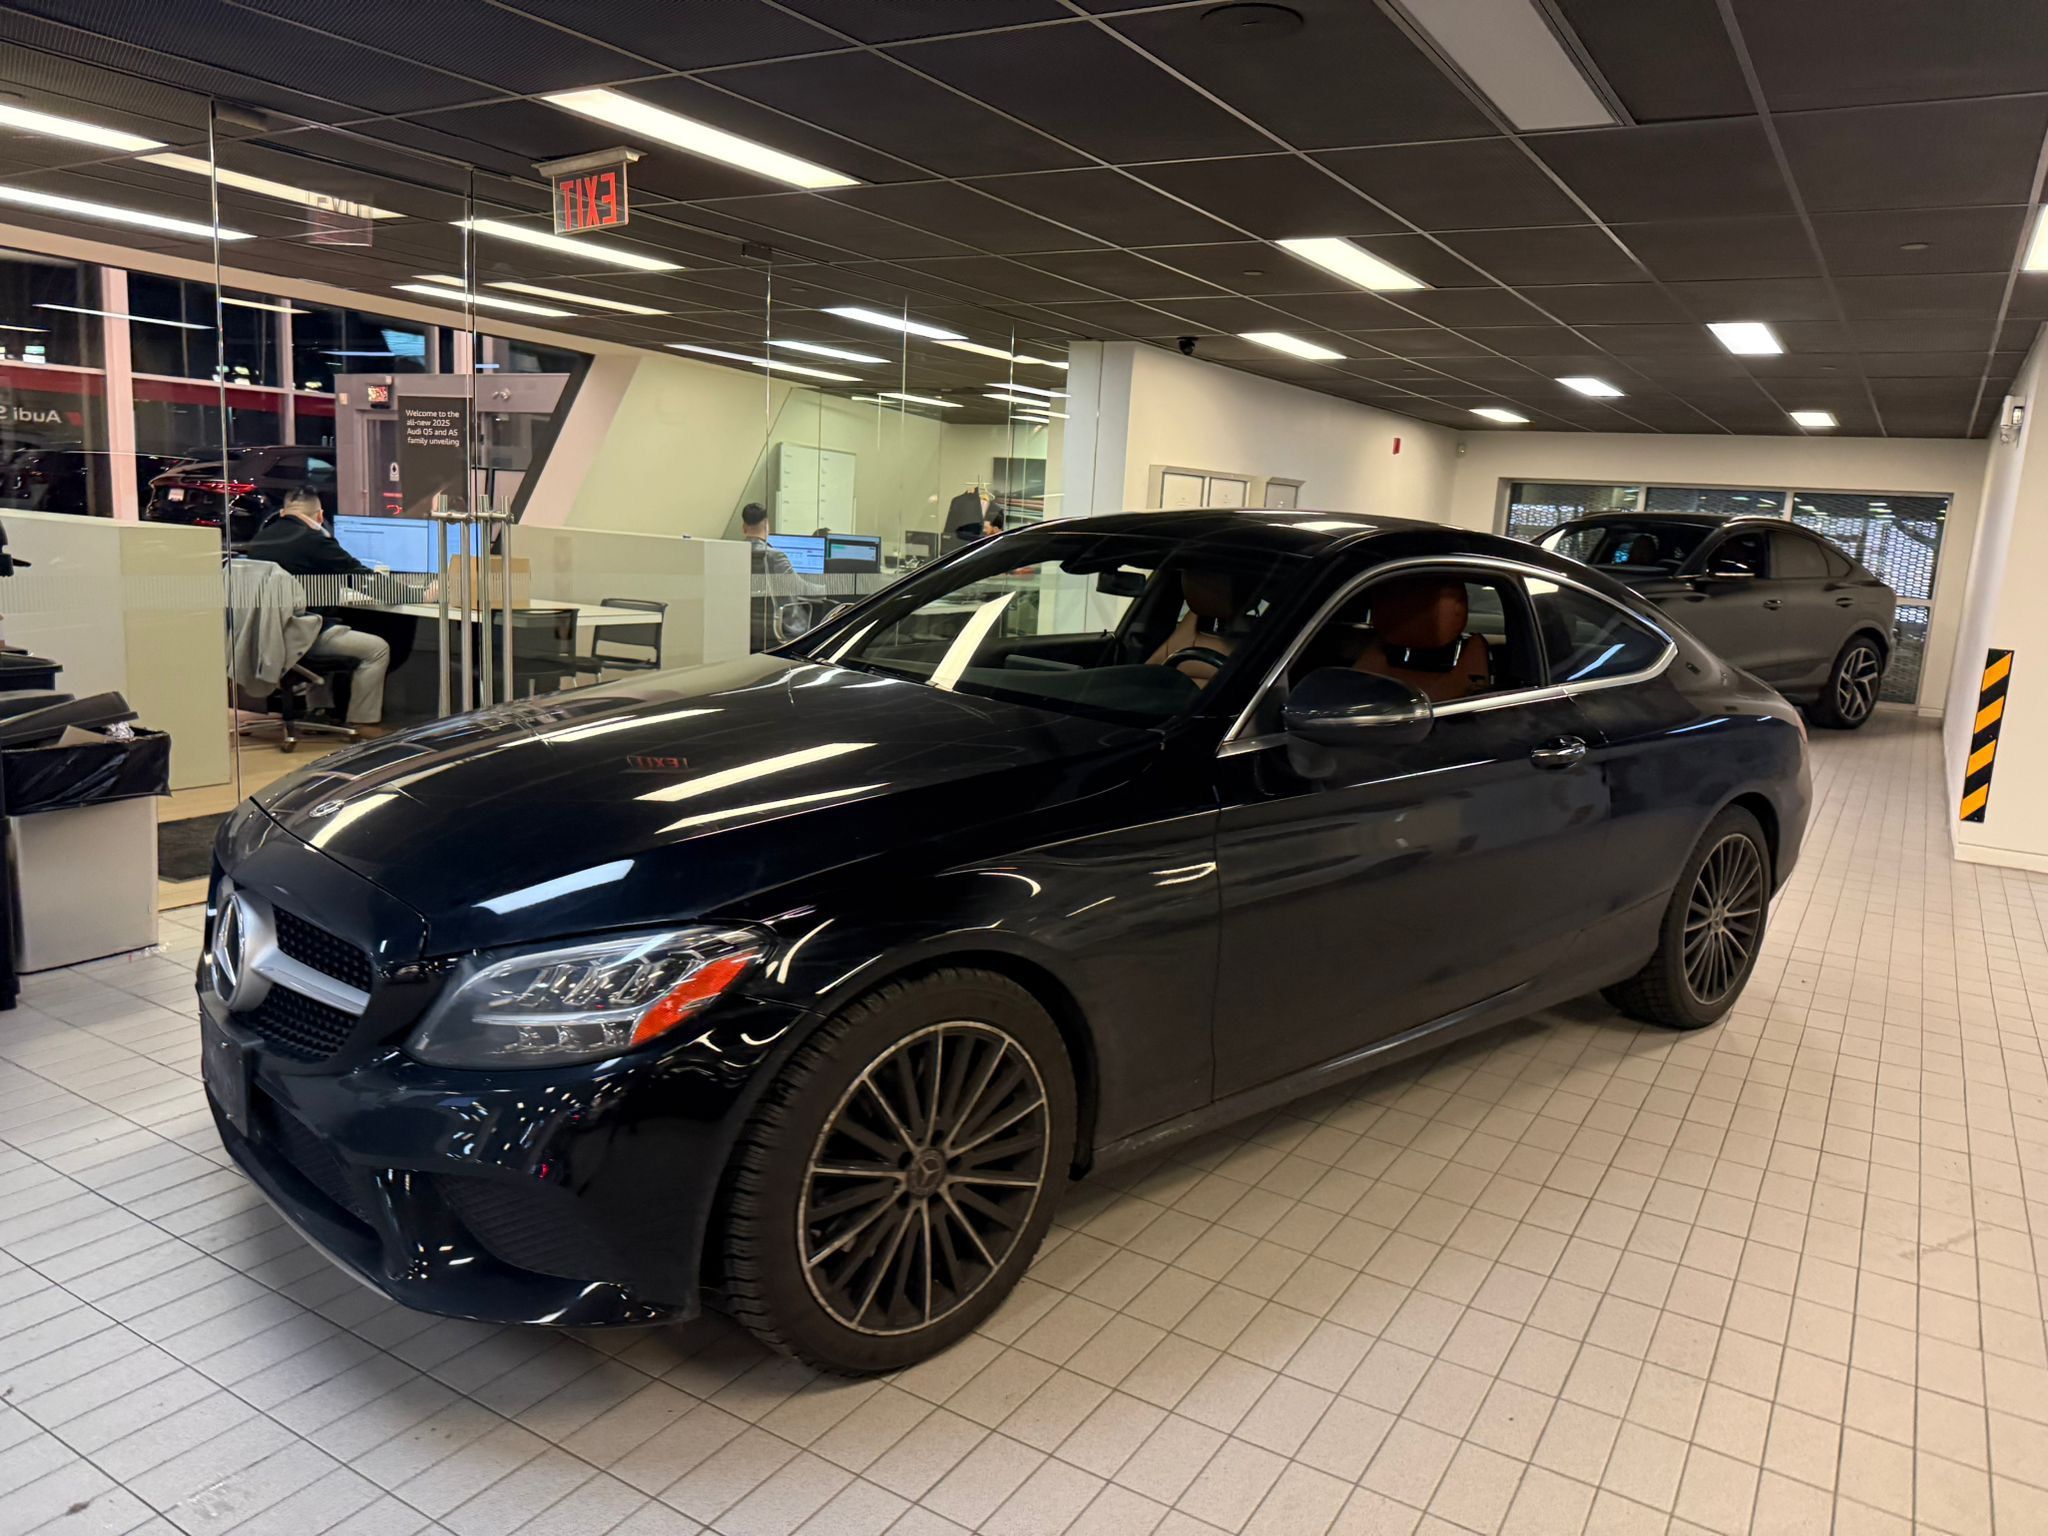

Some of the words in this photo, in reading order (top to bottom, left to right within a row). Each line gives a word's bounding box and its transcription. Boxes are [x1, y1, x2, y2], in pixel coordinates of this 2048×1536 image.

[405, 409, 437, 417] Welcome
[447, 410, 460, 418] the
[432, 419, 450, 427] 2025
[434, 428, 447, 436] and
[407, 436, 428, 446] family
[429, 438, 460, 447] unveiling
